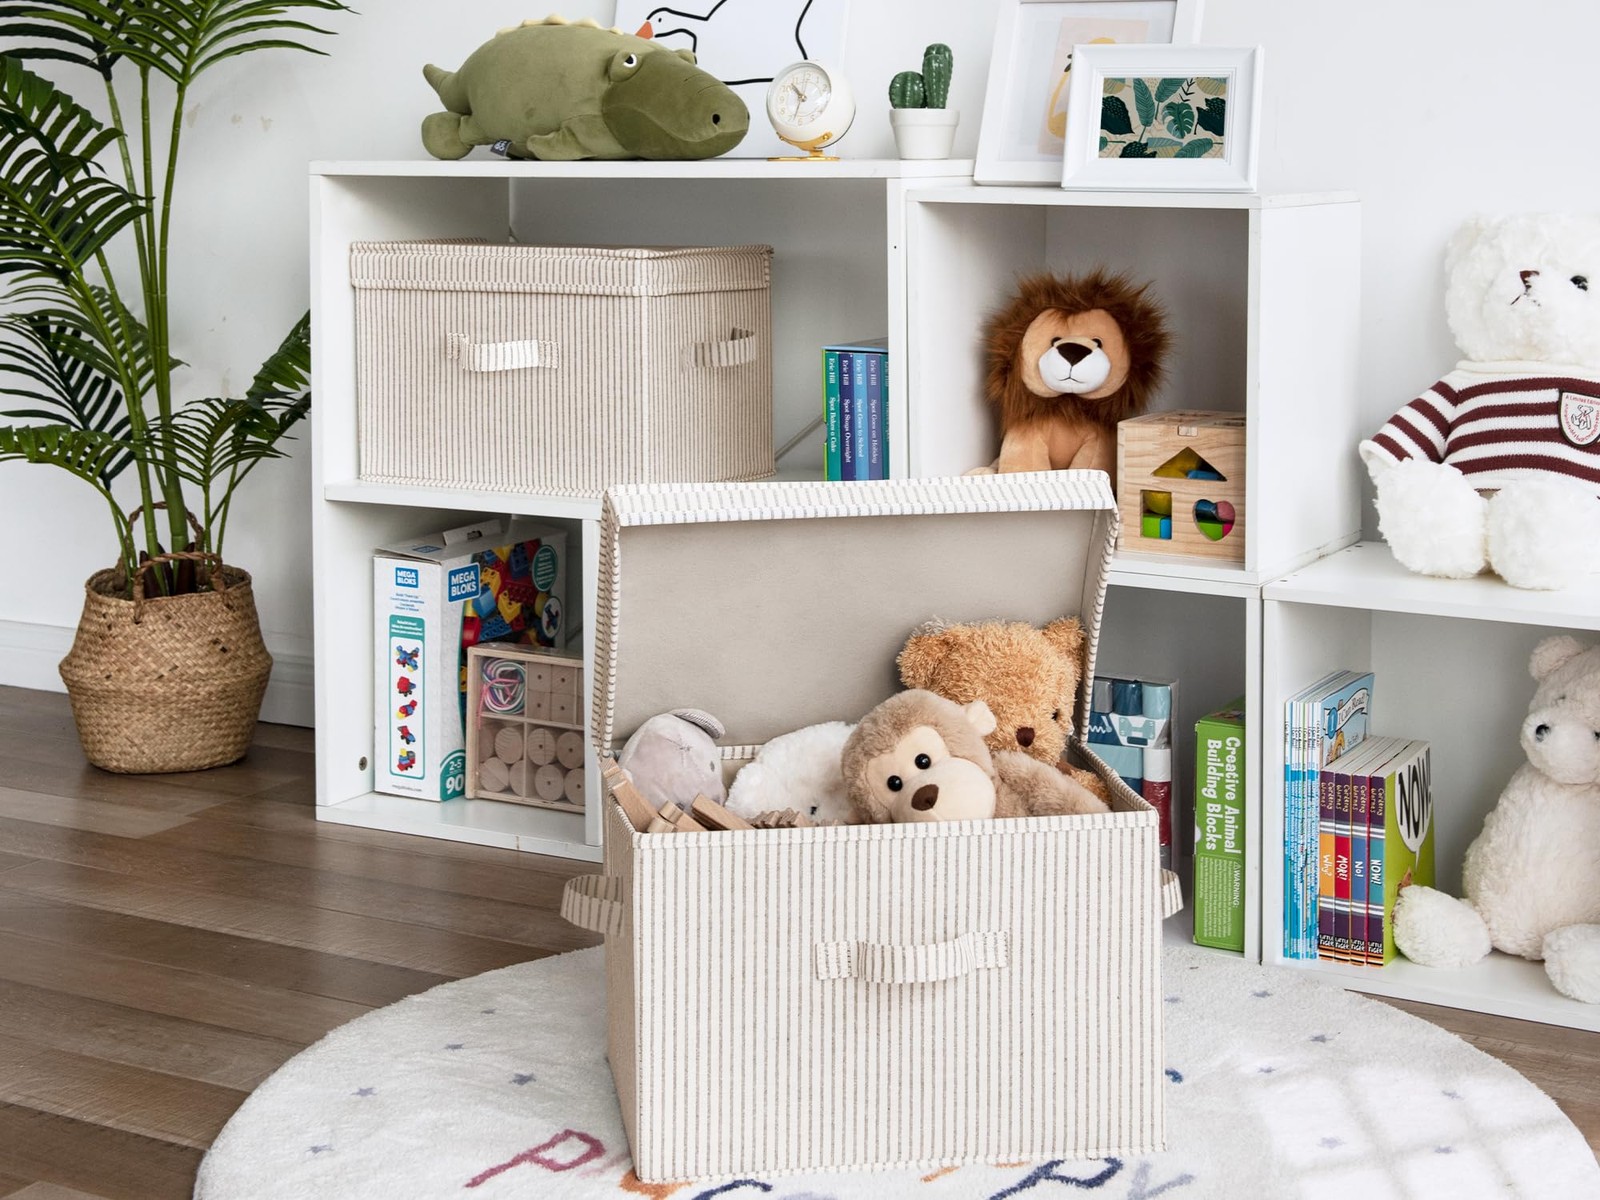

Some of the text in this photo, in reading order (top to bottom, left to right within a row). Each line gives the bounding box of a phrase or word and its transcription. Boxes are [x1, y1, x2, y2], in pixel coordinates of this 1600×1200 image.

[397, 570, 416, 578] MEGA
[397, 578, 417, 586] BLOKS
[451, 571, 476, 585] MEGA
[451, 582, 477, 596] BLOKS
[1202, 739, 1224, 799] Building
[445, 774, 464, 795] 90
[1224, 737, 1242, 854] Creative Animal
[1398, 747, 1431, 839] NOW!
[1206, 803, 1223, 850] Blocks
[1322, 855, 1332, 877] Why?
[1336, 855, 1348, 880] MORE!
[1355, 861, 1363, 877] No!
[1371, 860, 1382, 885] NOW!
[1233, 870, 1241, 908] WARNING:
